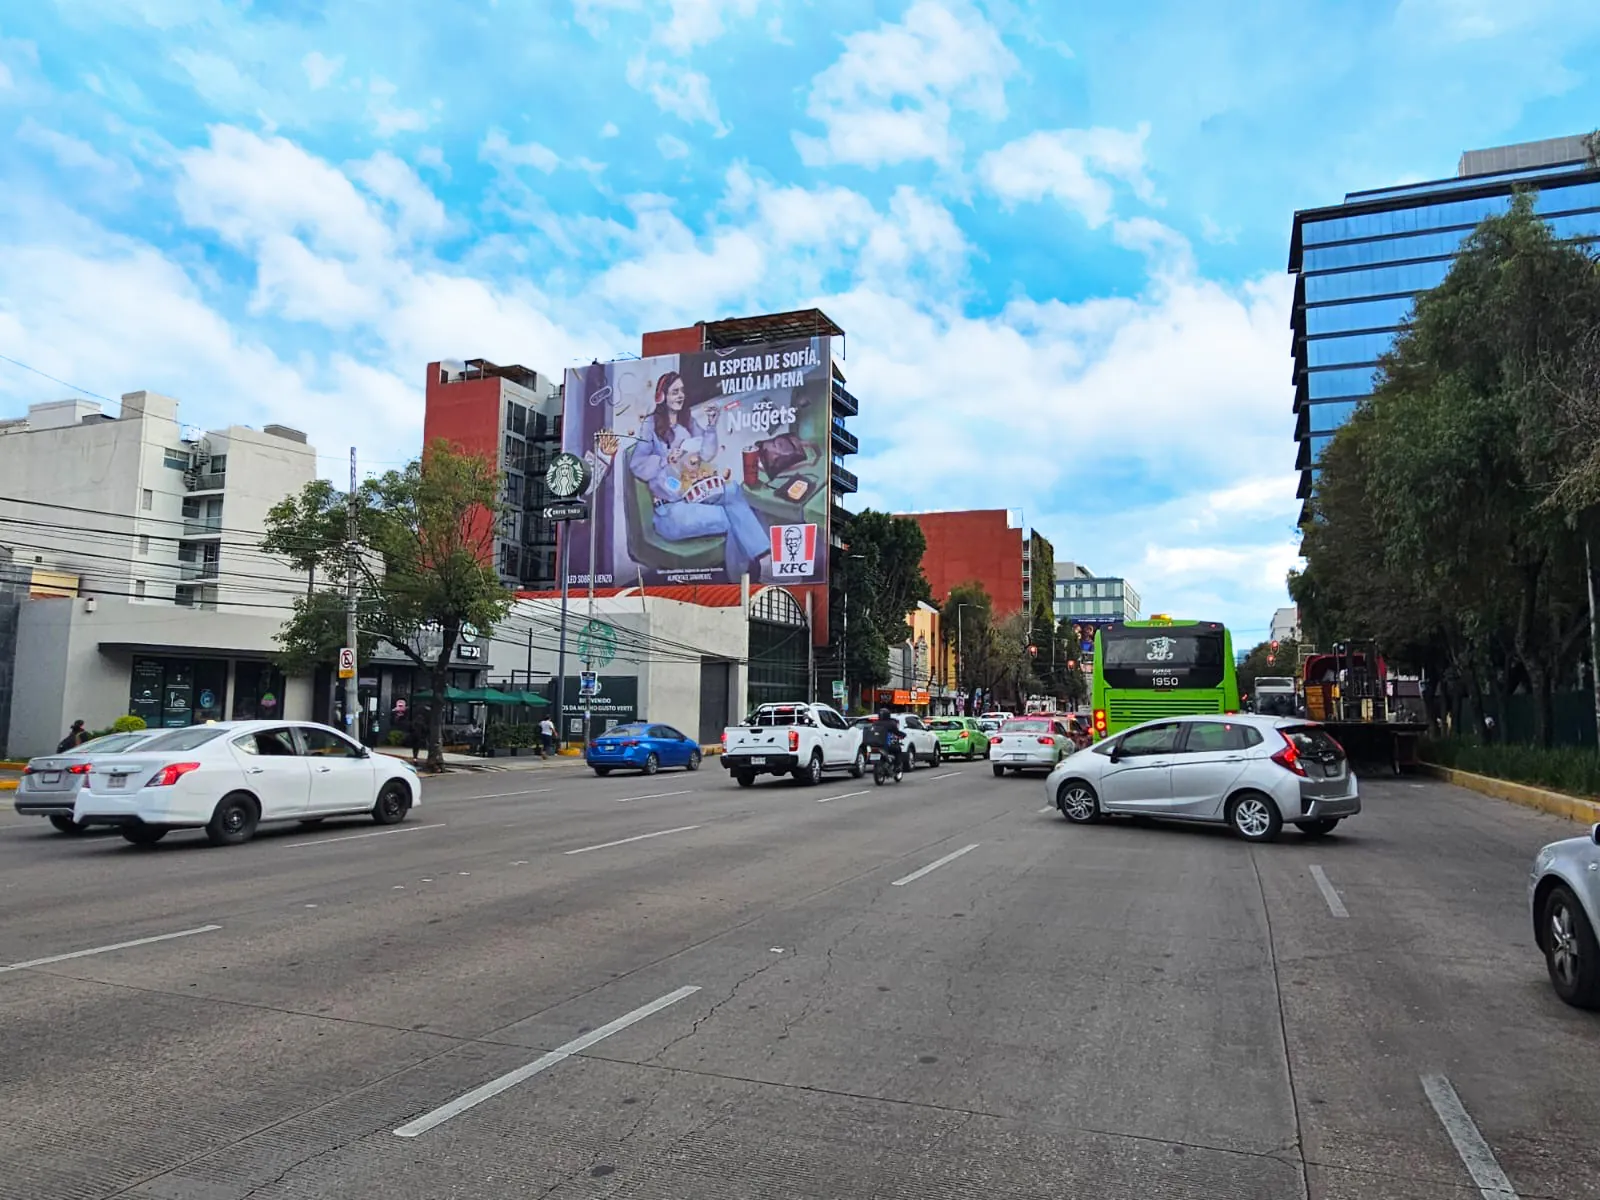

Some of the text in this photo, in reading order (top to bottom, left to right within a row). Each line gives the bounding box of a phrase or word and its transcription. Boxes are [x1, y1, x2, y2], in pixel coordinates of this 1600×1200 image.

[703, 361, 717, 377] LA
[719, 355, 762, 376] ESPERA
[765, 354, 780, 370] DE
[721, 370, 804, 394] VALIÓ LA PENA
[752, 401, 774, 411] KFC
[726, 405, 797, 432] Nuggets
[779, 562, 808, 574] KFC
[1152, 677, 1178, 686] 1950
